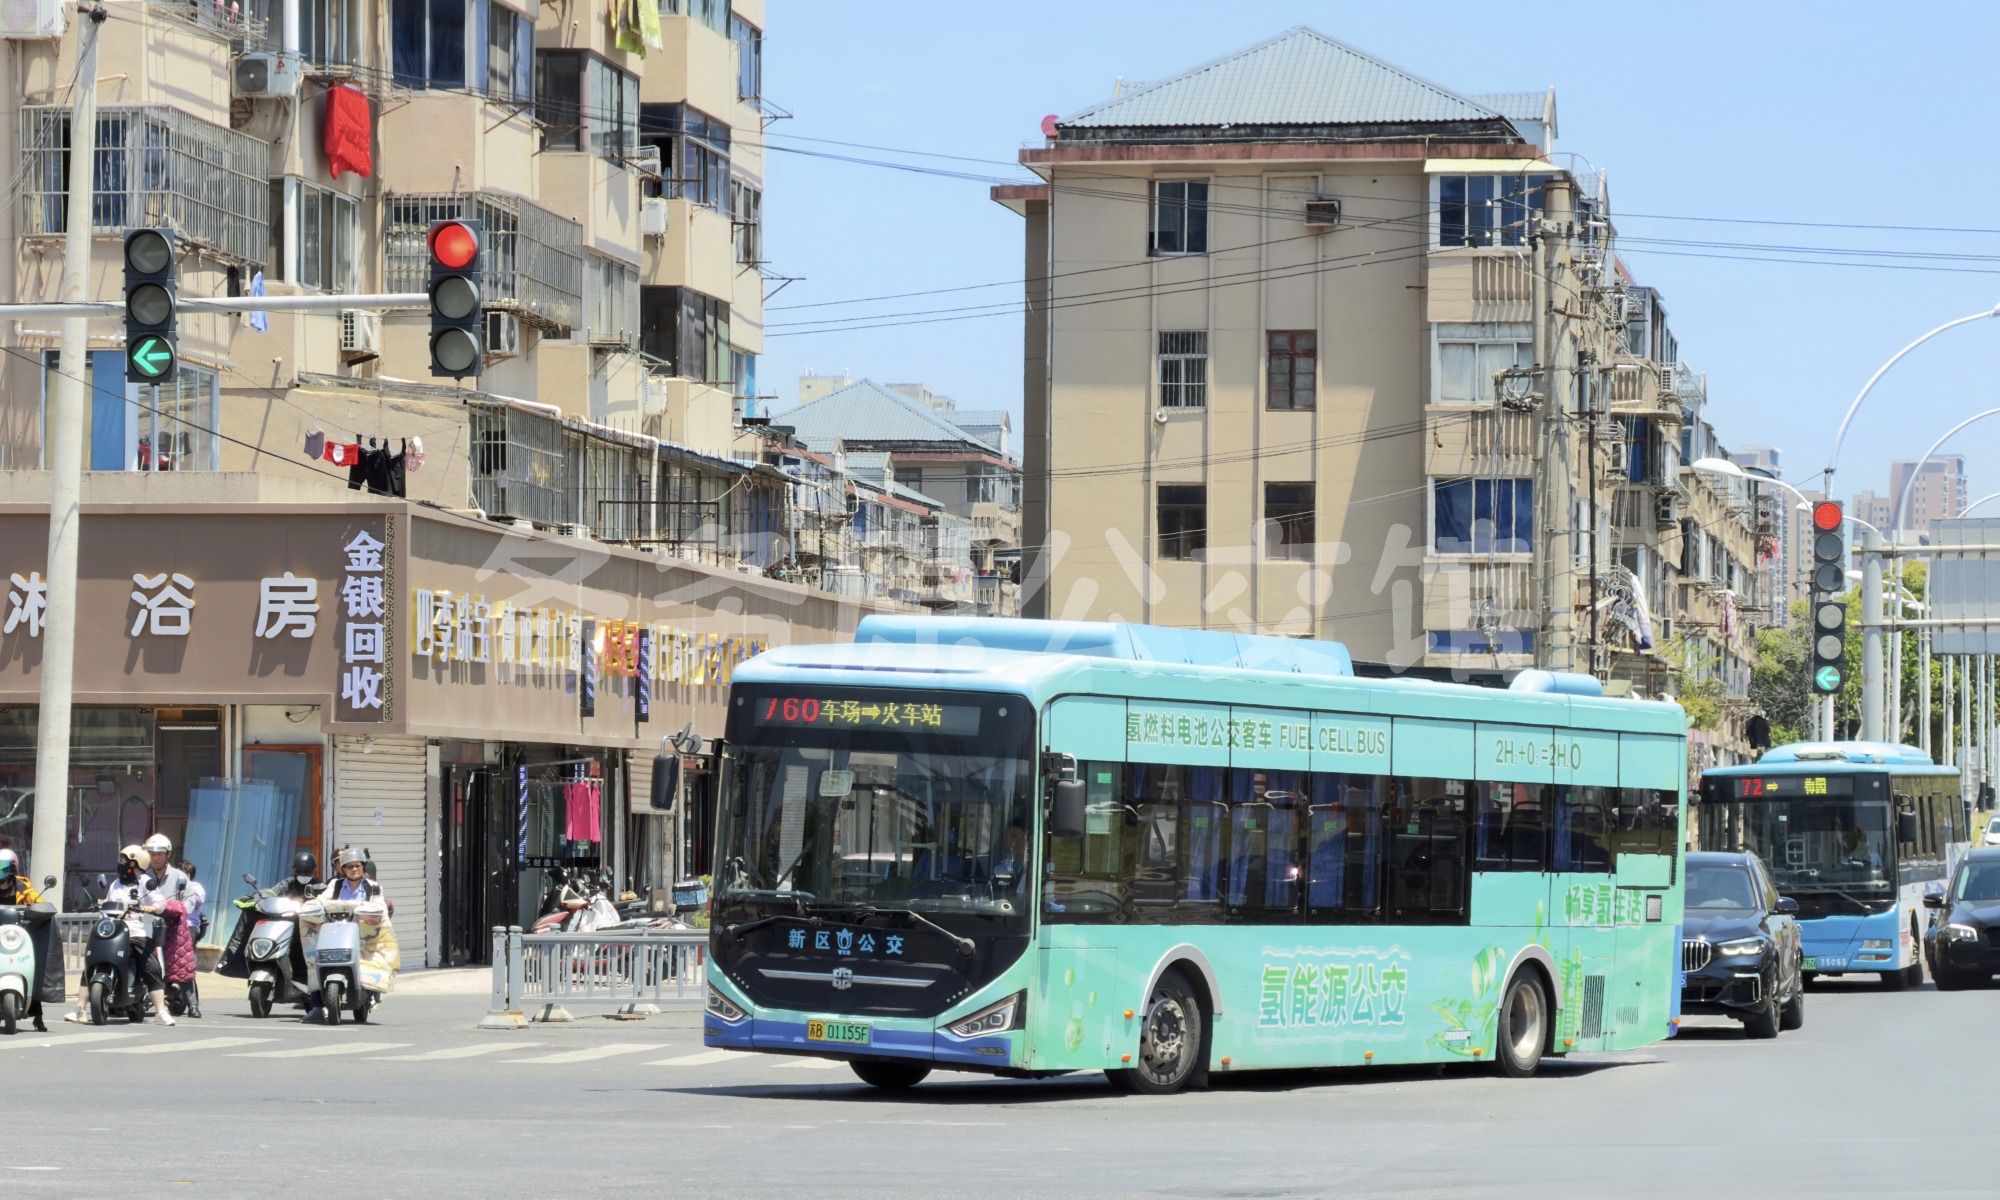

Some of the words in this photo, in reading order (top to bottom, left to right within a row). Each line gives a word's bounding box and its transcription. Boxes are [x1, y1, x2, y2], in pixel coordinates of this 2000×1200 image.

[342, 529, 386, 710] 金银回收
[416, 588, 492, 664] 四季珠宝
[820, 699, 861, 724] 车场
[881, 702, 943, 726] 火车站
[1127, 710, 1272, 751] 氢燃料电池公交客车
[1280, 724, 1315, 750] FUEL
[1319, 727, 1354, 753] CELL
[1357, 730, 1385, 755] BUS
[1742, 778, 1763, 796] 72
[1565, 883, 1642, 926] 畅享氢生活
[1257, 962, 1408, 1030] 氢能源公交
